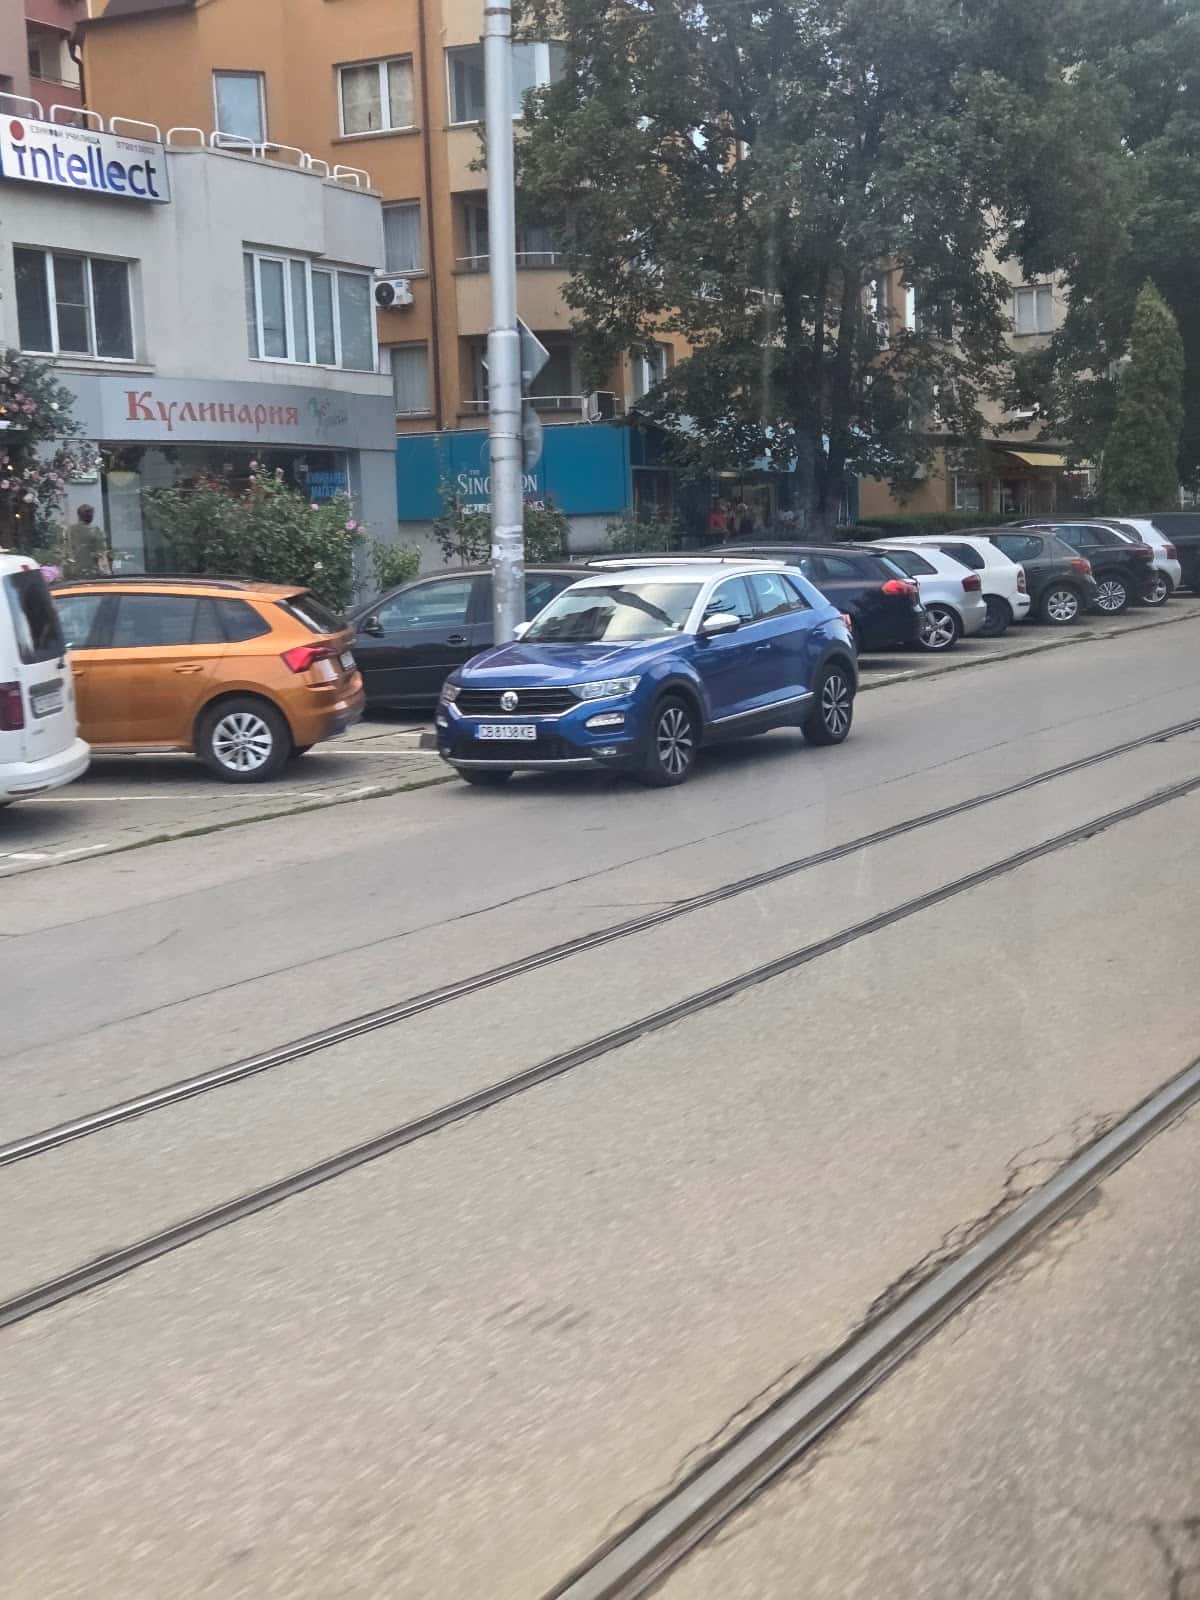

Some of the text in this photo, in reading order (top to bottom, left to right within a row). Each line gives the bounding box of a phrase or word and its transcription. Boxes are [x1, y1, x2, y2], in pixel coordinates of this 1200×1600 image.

[10, 120, 160, 197] intellect
[124, 391, 299, 432] Кулинария
[457, 473, 538, 495] SINGON
